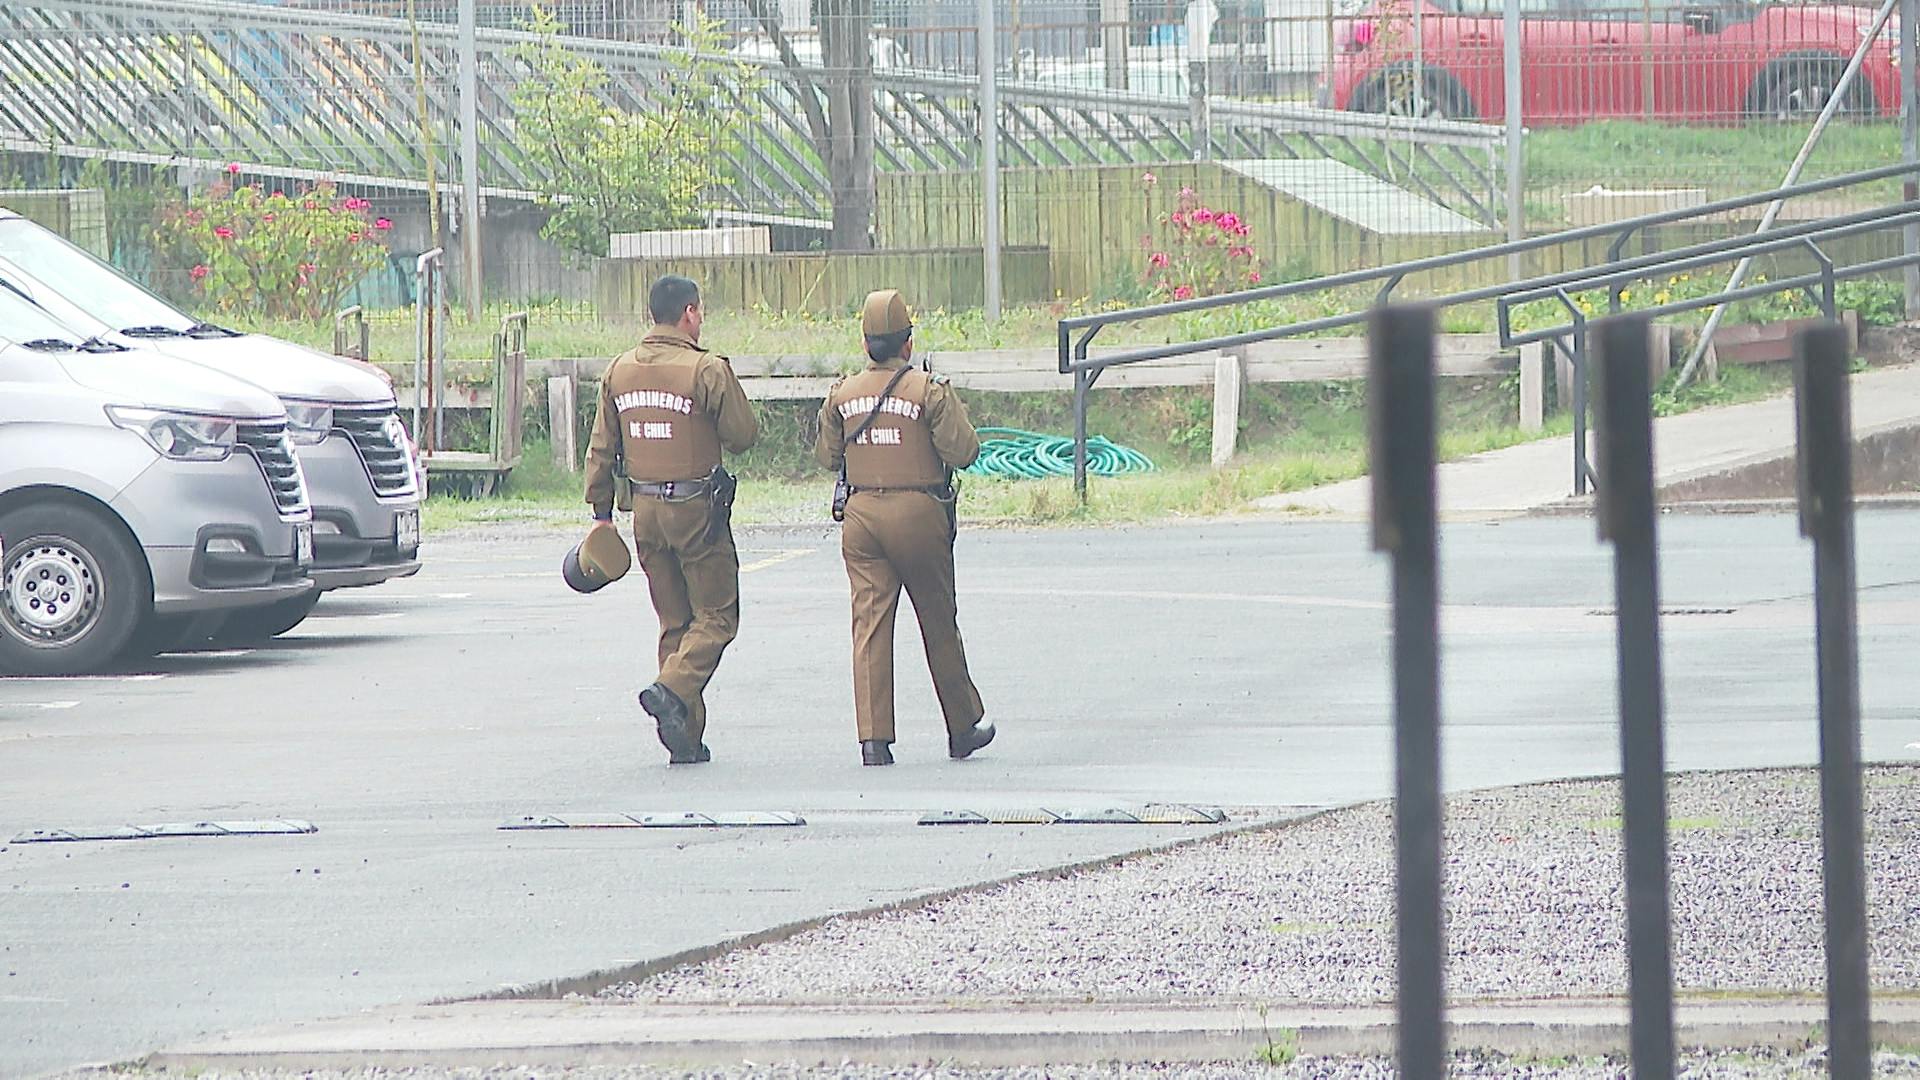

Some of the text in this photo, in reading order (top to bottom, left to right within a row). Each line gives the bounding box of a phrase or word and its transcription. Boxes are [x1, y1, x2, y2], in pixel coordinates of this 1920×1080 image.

[629, 421, 673, 439] DE CHILE
[870, 428, 901, 445] CHILE
